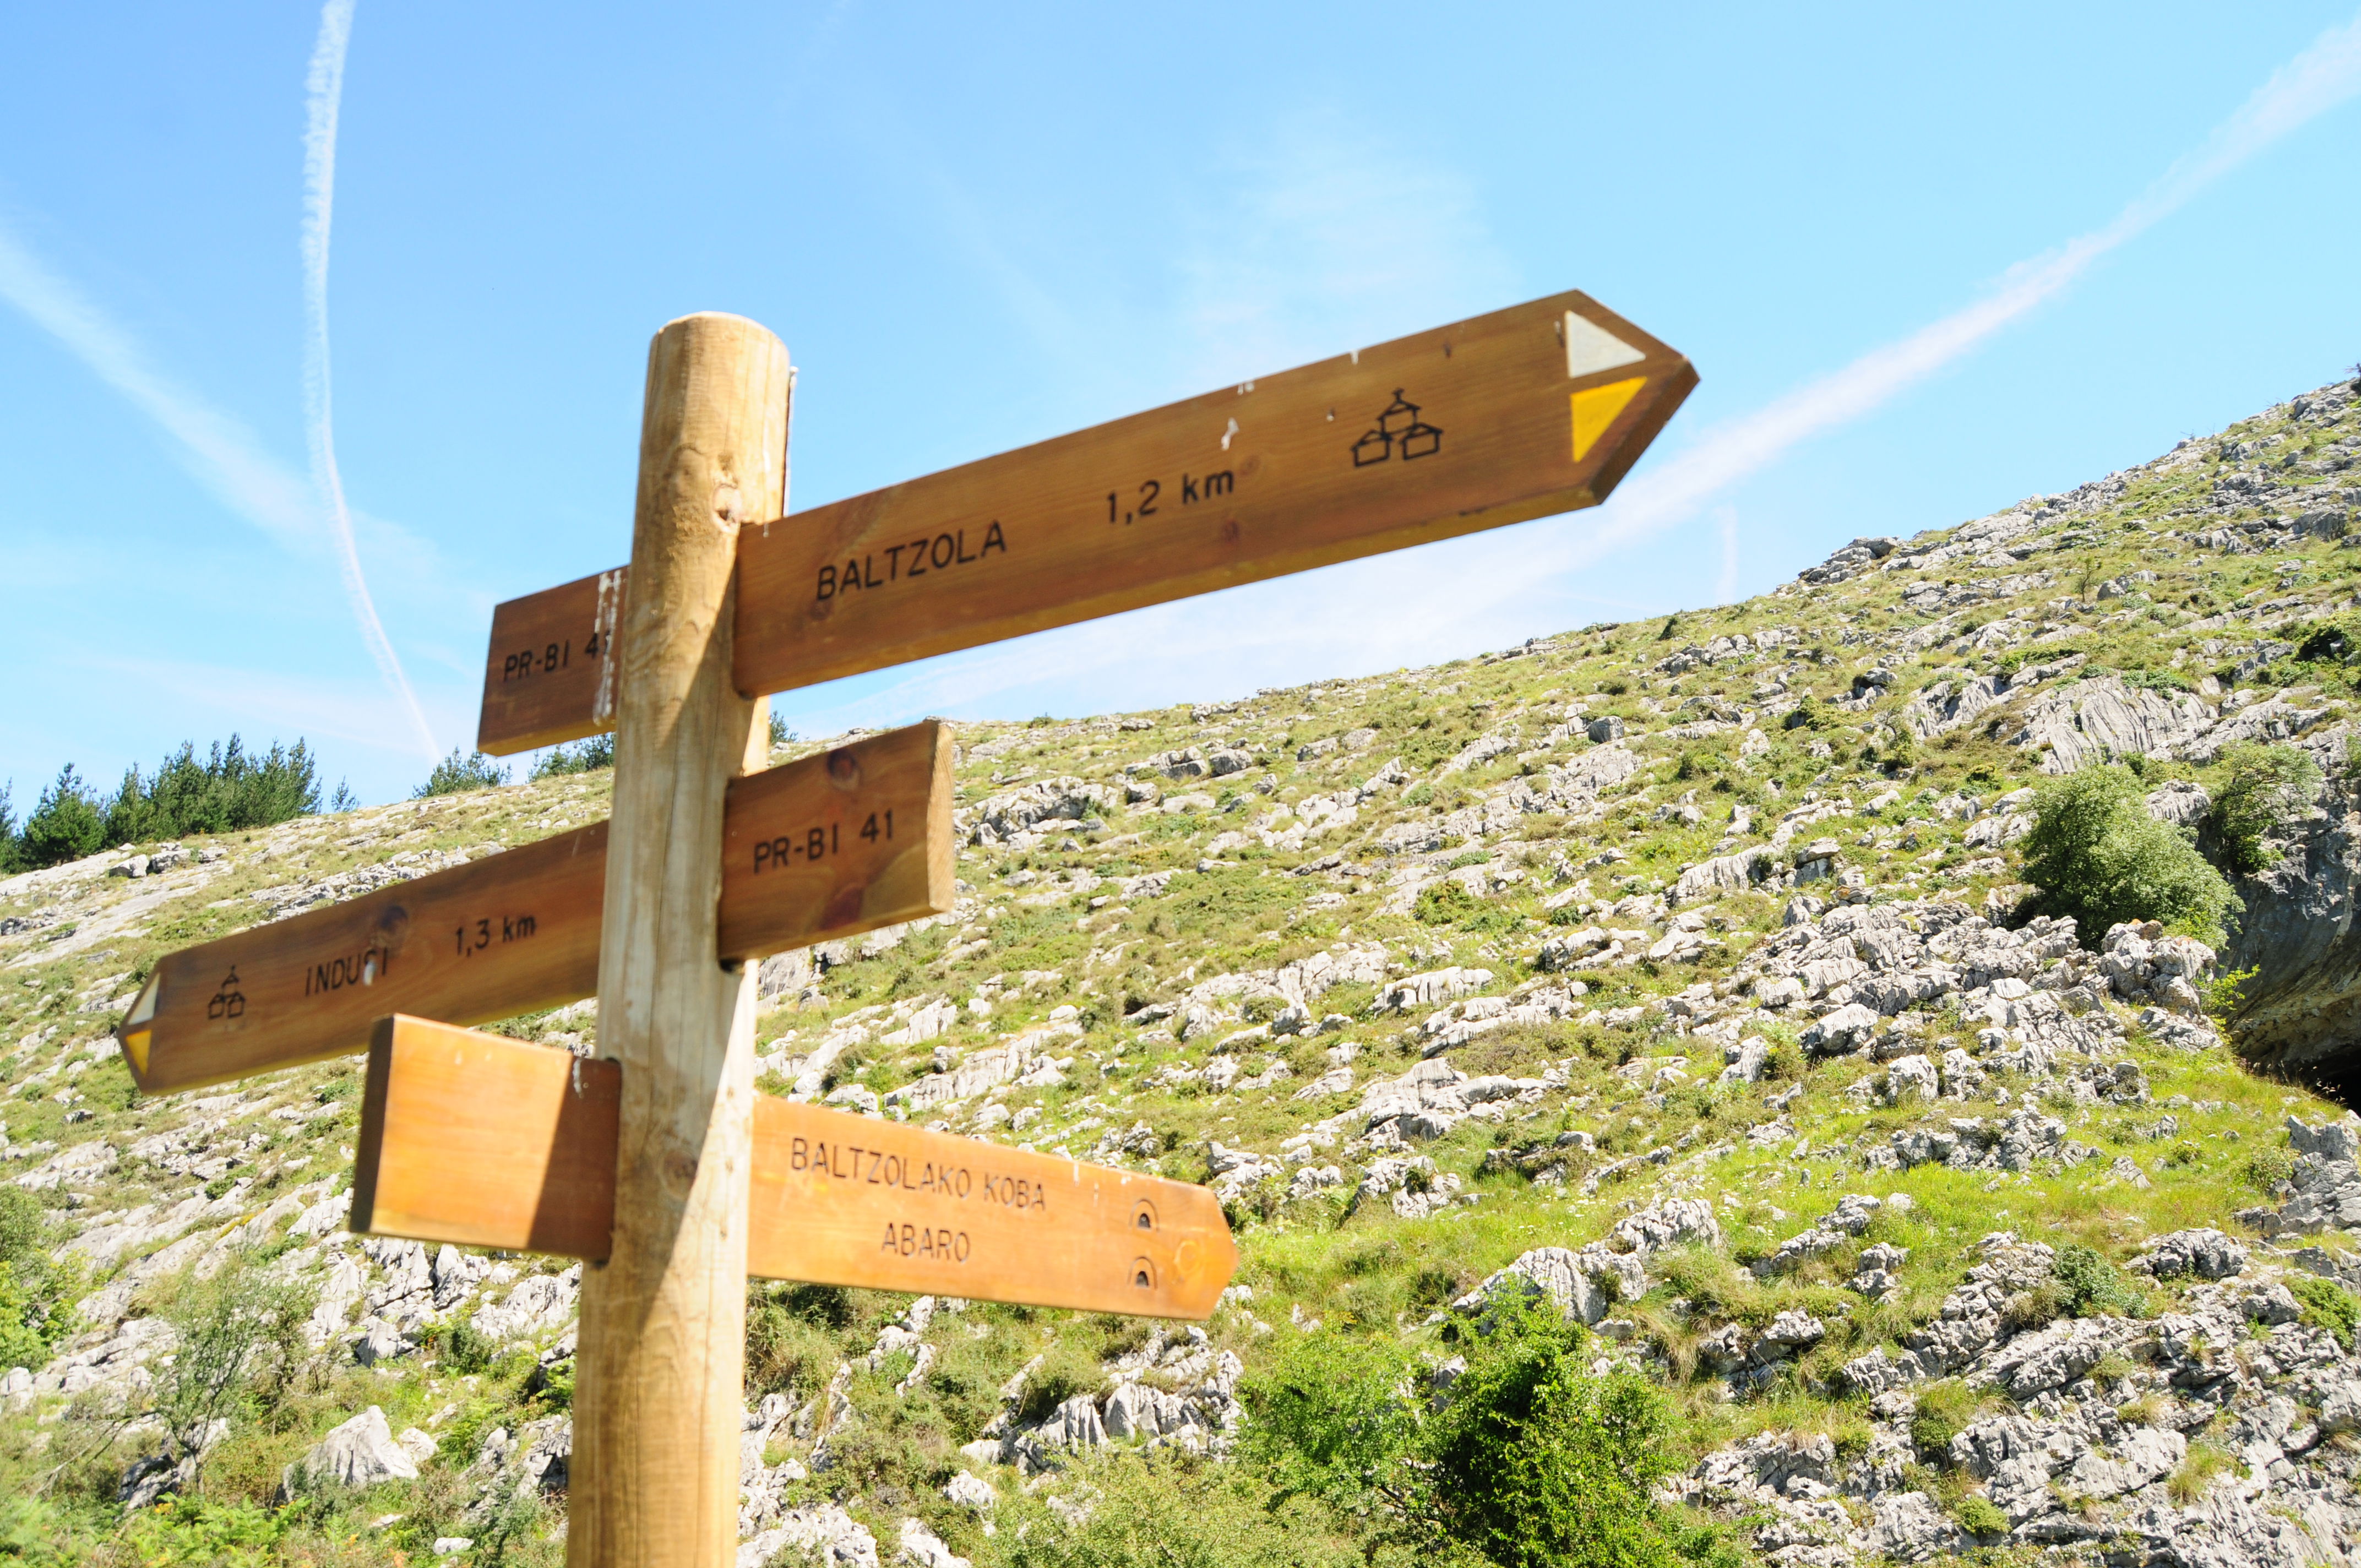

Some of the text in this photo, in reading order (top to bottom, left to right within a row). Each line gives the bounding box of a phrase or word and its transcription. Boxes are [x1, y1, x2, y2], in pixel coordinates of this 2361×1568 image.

[817, 470, 1234, 601] BALTZOLA 1,2 km
[503, 639, 570, 682] PR-BI
[753, 808, 893, 874] PR-BI 41
[455, 919, 490, 957] 1,3
[502, 914, 537, 943] km
[791, 1137, 1047, 1211] BALTZOLAKO KOBA
[882, 1222, 971, 1264] ABARO
